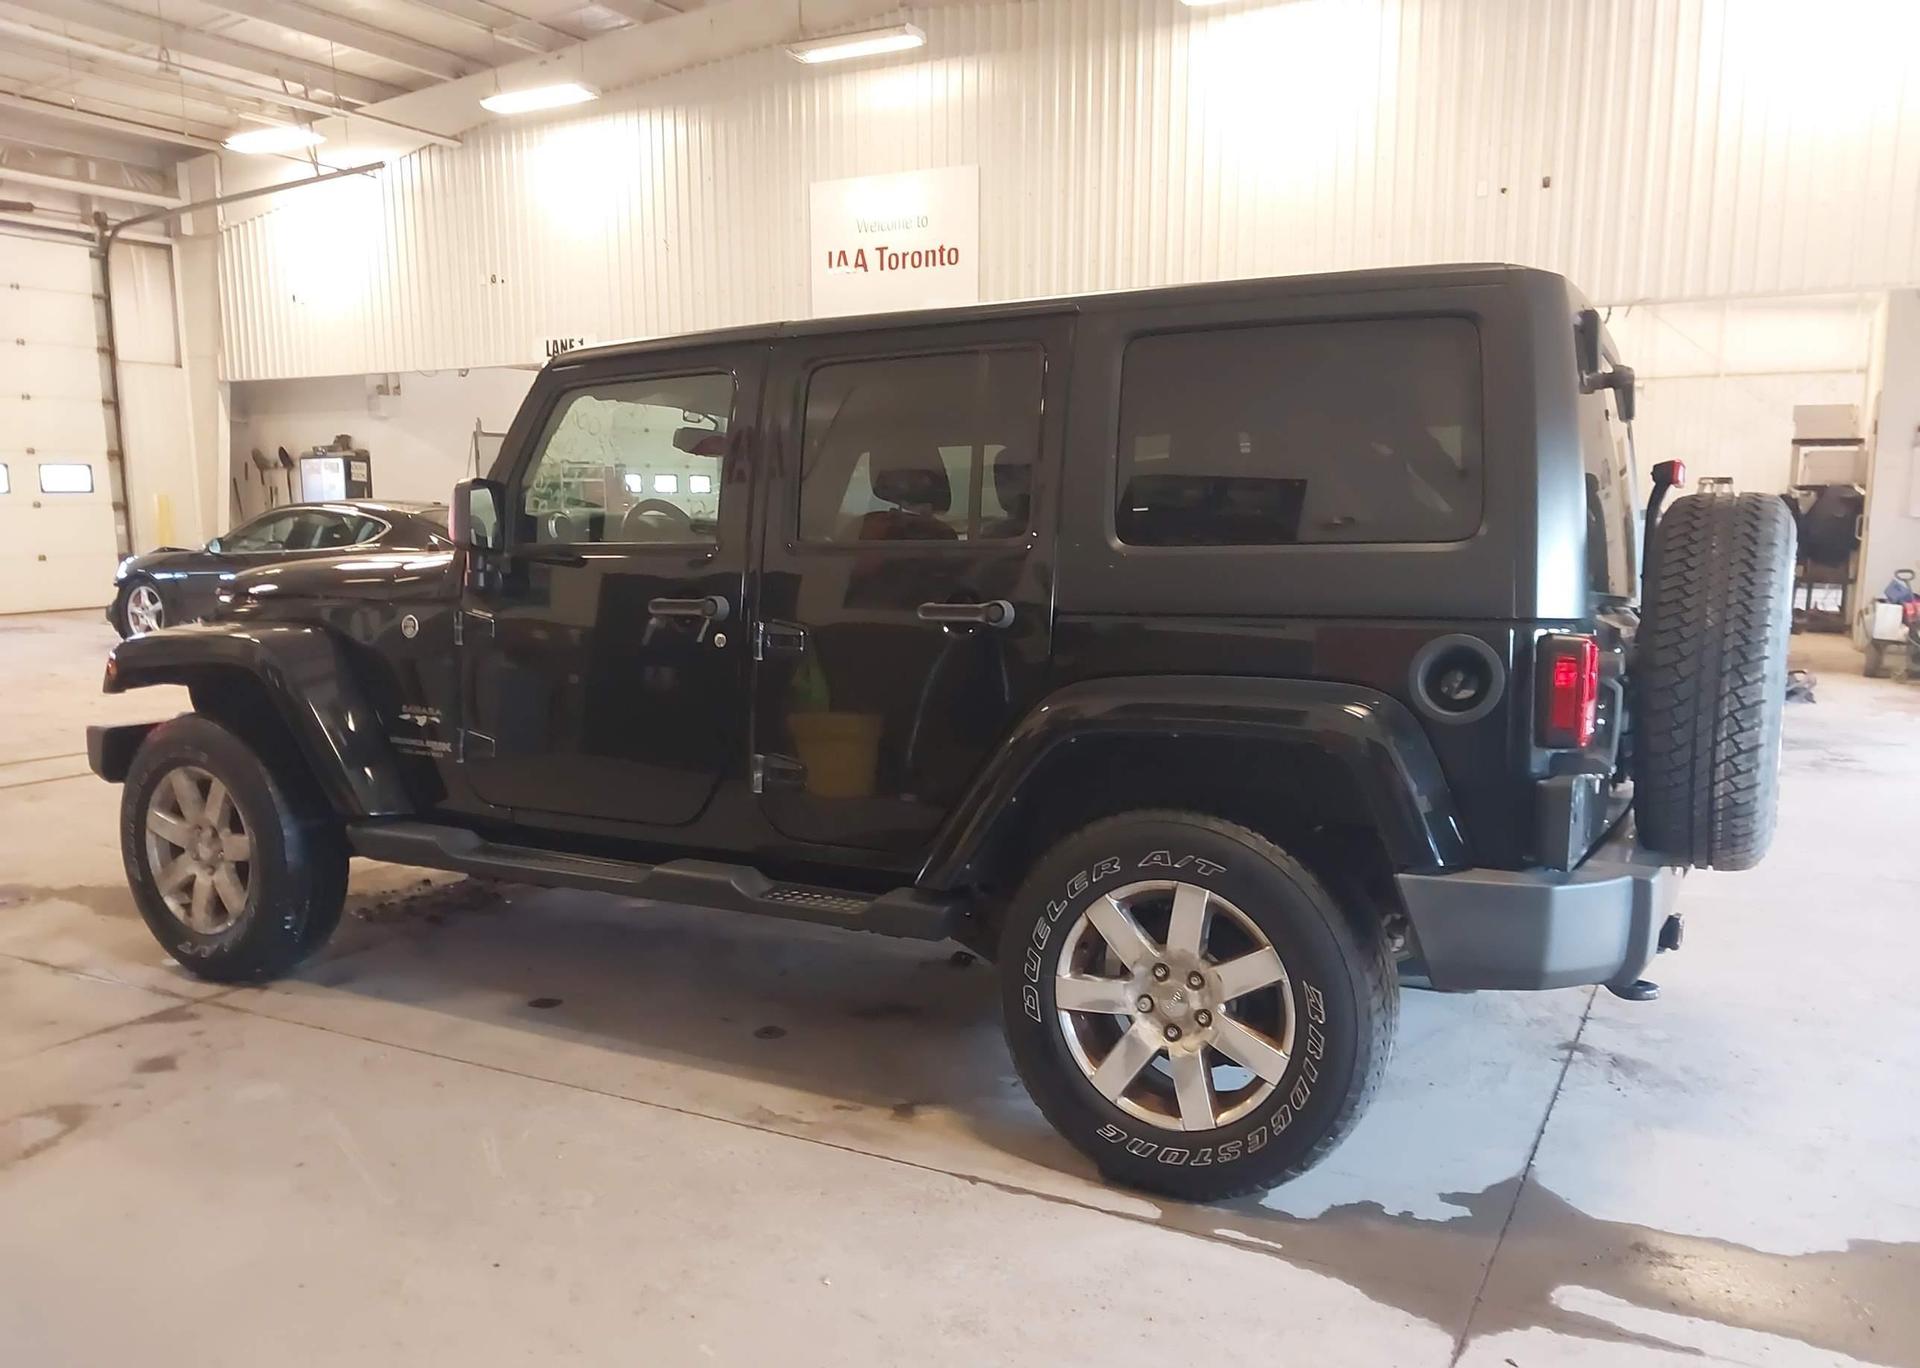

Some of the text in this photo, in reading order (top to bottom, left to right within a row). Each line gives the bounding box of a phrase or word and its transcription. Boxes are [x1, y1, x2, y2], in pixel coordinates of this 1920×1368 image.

[856, 215, 929, 233] Welcome to
[827, 244, 960, 272] IAA Toronto
[546, 338, 575, 357] LANE
[1022, 850, 1227, 1023] DUELER A/T
[1097, 980, 1326, 1166] BRIDGESTONE
